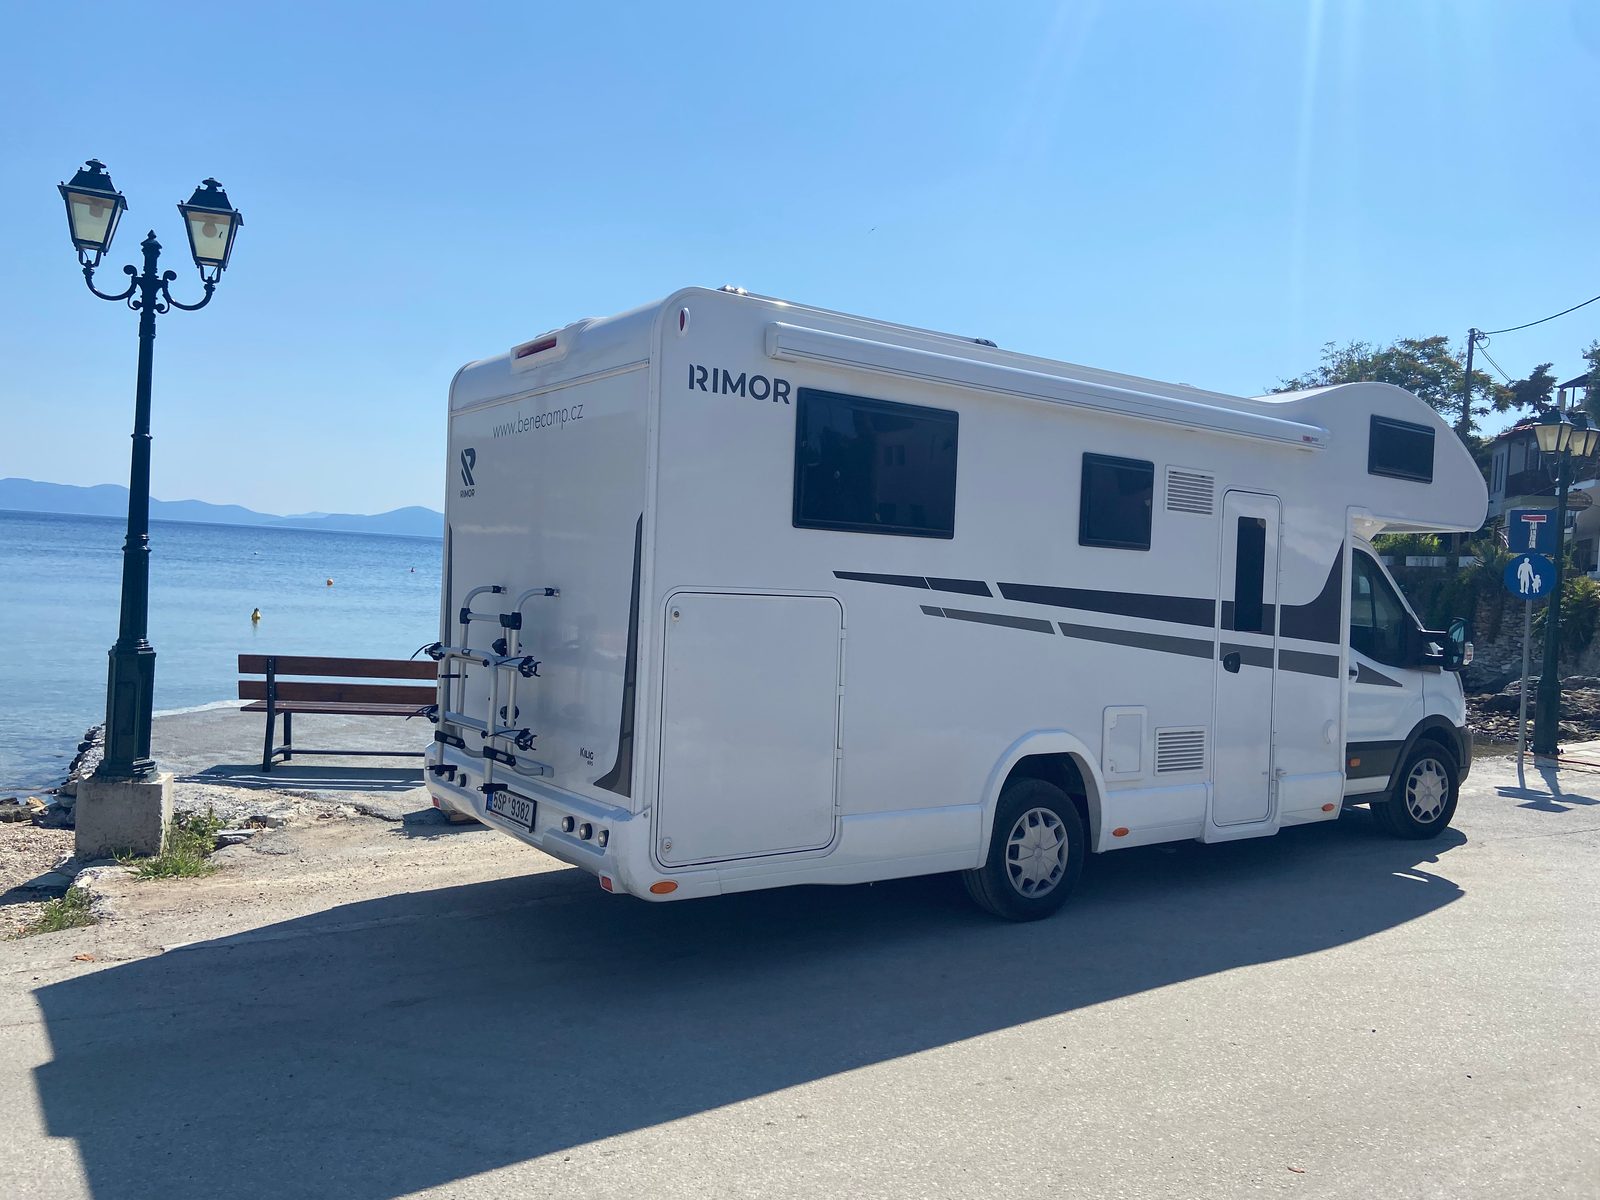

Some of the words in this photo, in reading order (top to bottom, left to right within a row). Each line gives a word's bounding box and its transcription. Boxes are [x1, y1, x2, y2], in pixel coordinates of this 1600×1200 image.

[688, 363, 792, 405] RIMOR
[492, 403, 584, 439] www.benecamp.cz
[459, 488, 476, 498] RIMOR
[493, 791, 507, 811] 5SP
[511, 798, 530, 822] 9382
